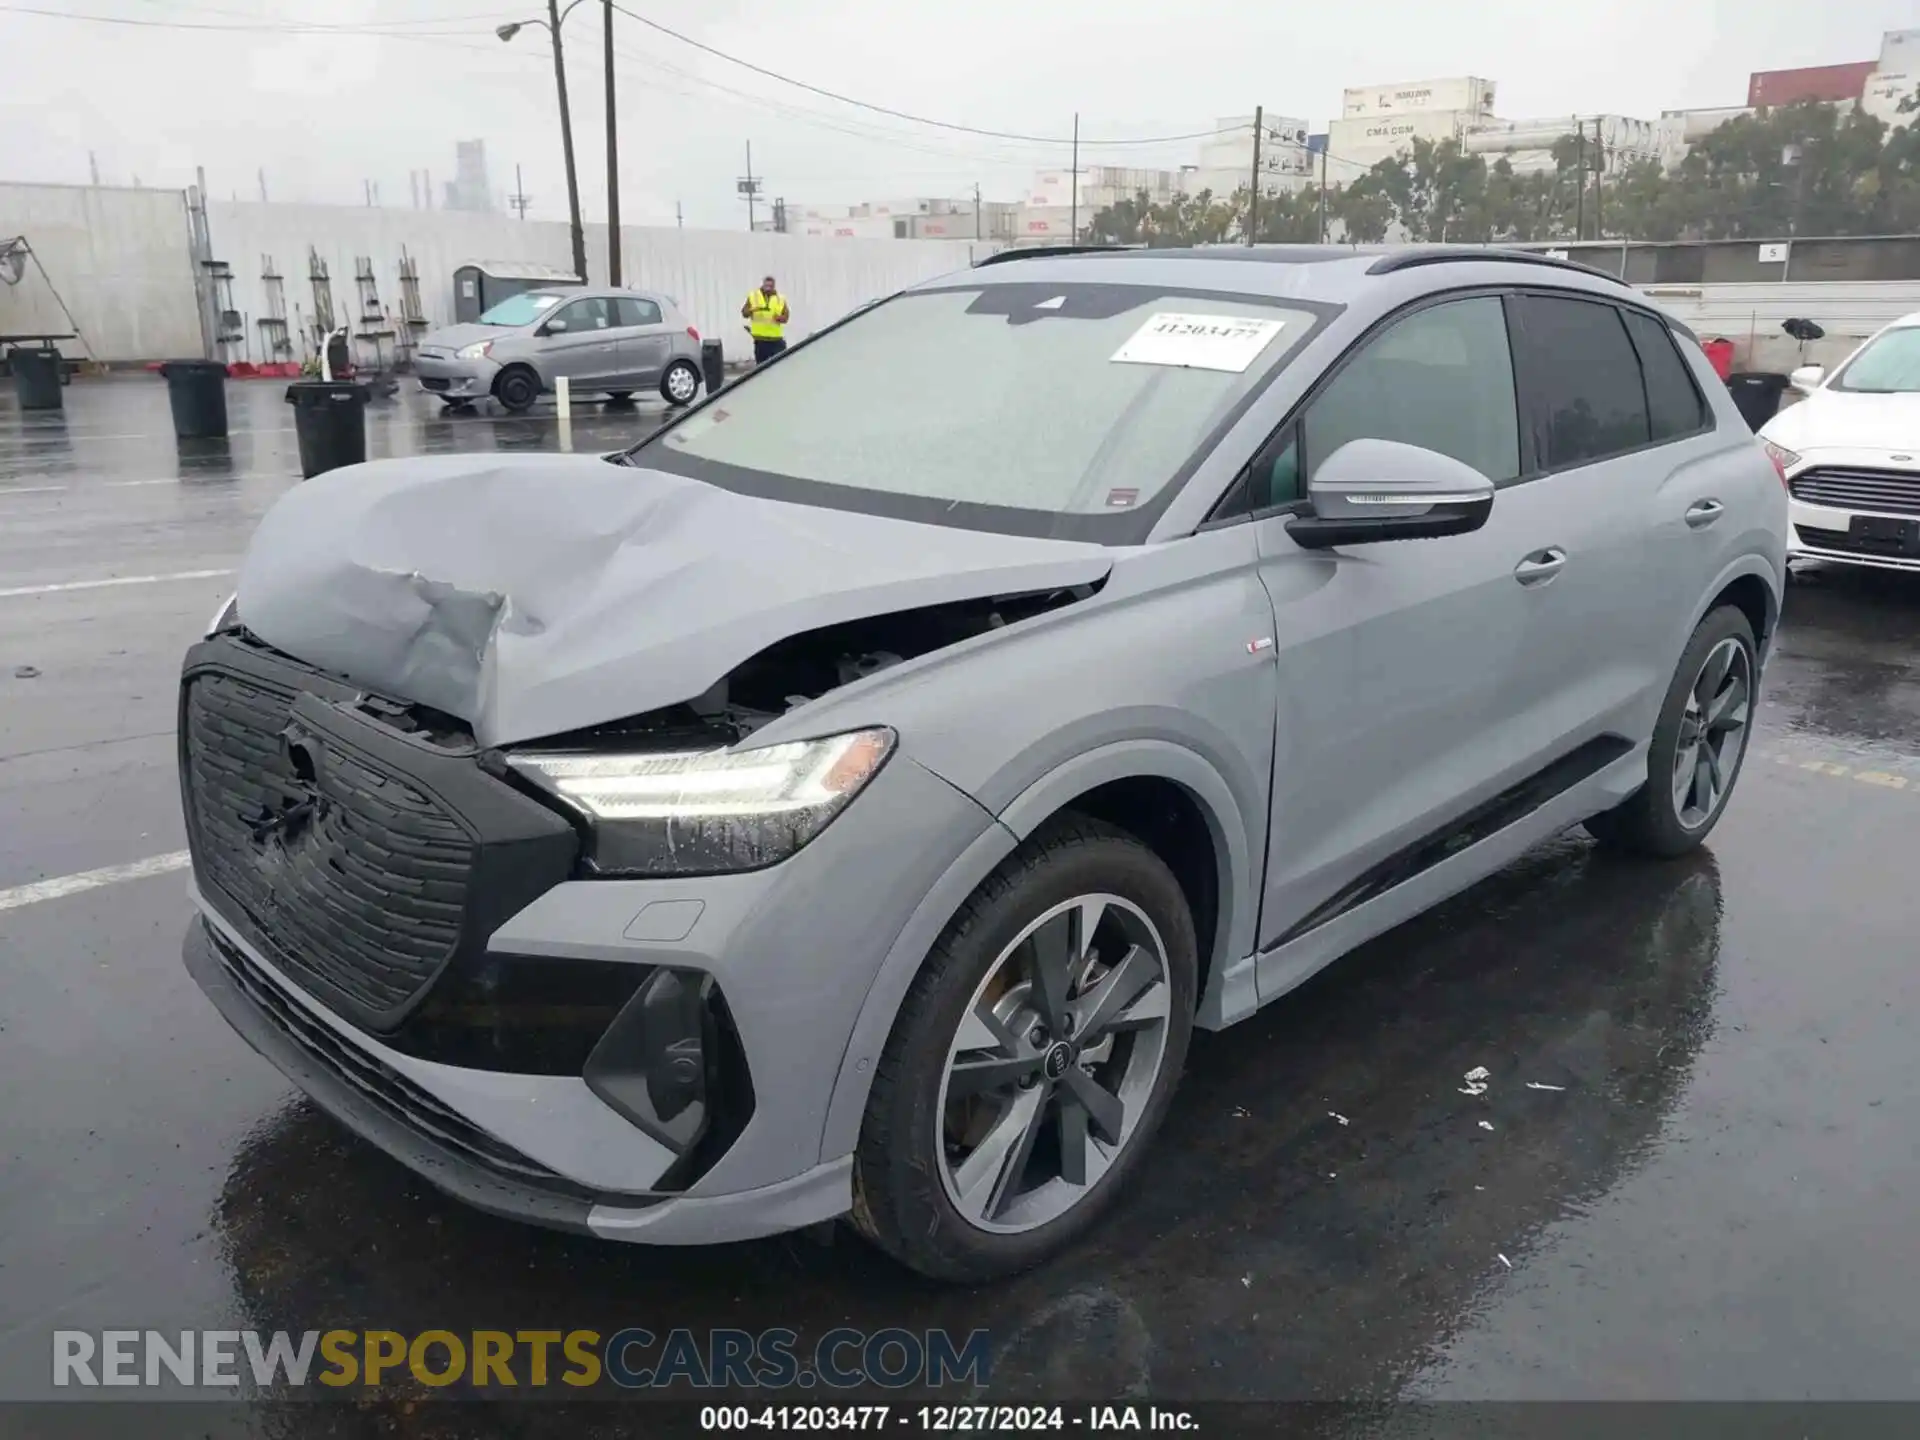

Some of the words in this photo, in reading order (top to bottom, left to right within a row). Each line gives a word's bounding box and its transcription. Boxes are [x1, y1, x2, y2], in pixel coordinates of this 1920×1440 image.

[1366, 128, 1389, 137] CMA
[1391, 125, 1414, 136] CGM
[1769, 248, 1777, 257] 5
[1153, 323, 1260, 340] 41203477
